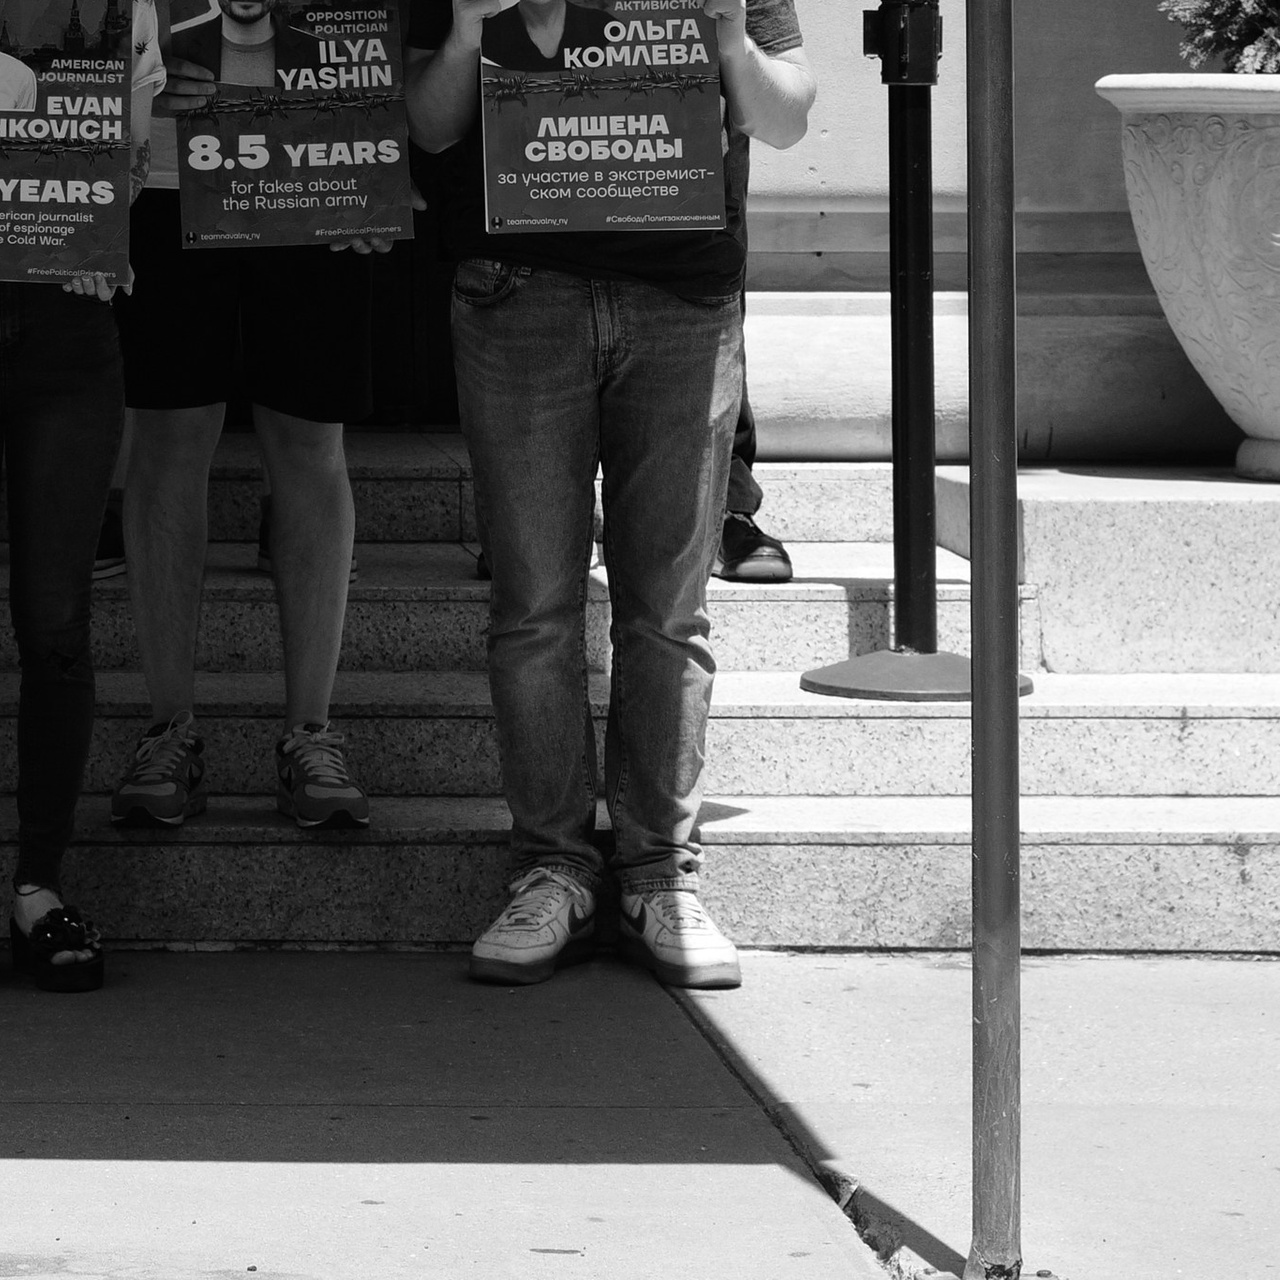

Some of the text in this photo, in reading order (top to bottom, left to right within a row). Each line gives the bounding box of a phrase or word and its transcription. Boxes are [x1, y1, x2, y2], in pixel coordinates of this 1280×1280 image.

[614, 0, 700, 11] АКТИВИСТК
[306, 10, 387, 22] OPPOSITION
[315, 23, 388, 35] POLITICIAN
[603, 19, 701, 43] ОЛЬГА
[319, 38, 388, 64] ILYA
[563, 43, 709, 68] КОМЛЕВА
[51, 59, 125, 70] AMERICAN
[38, 72, 124, 83] JOURNALIST
[276, 65, 393, 91] YASHIN
[47, 96, 121, 116] EVAN
[537, 114, 669, 138] ЛИШЕНА
[188, 134, 400, 171] 8.5 YEARS
[524, 138, 683, 162] СВОБОДЫ
[498, 167, 715, 186] за участие в экстремист-
[231, 178, 357, 195] for fakes about
[530, 183, 679, 199] ском сообществе
[223, 194, 368, 211] the Russian army
[37, 210, 94, 224] journalist
[0, 222, 11, 233] of
[14, 223, 75, 236] espionage
[7, 234, 37, 245] Cold
[40, 235, 66, 246] War.
